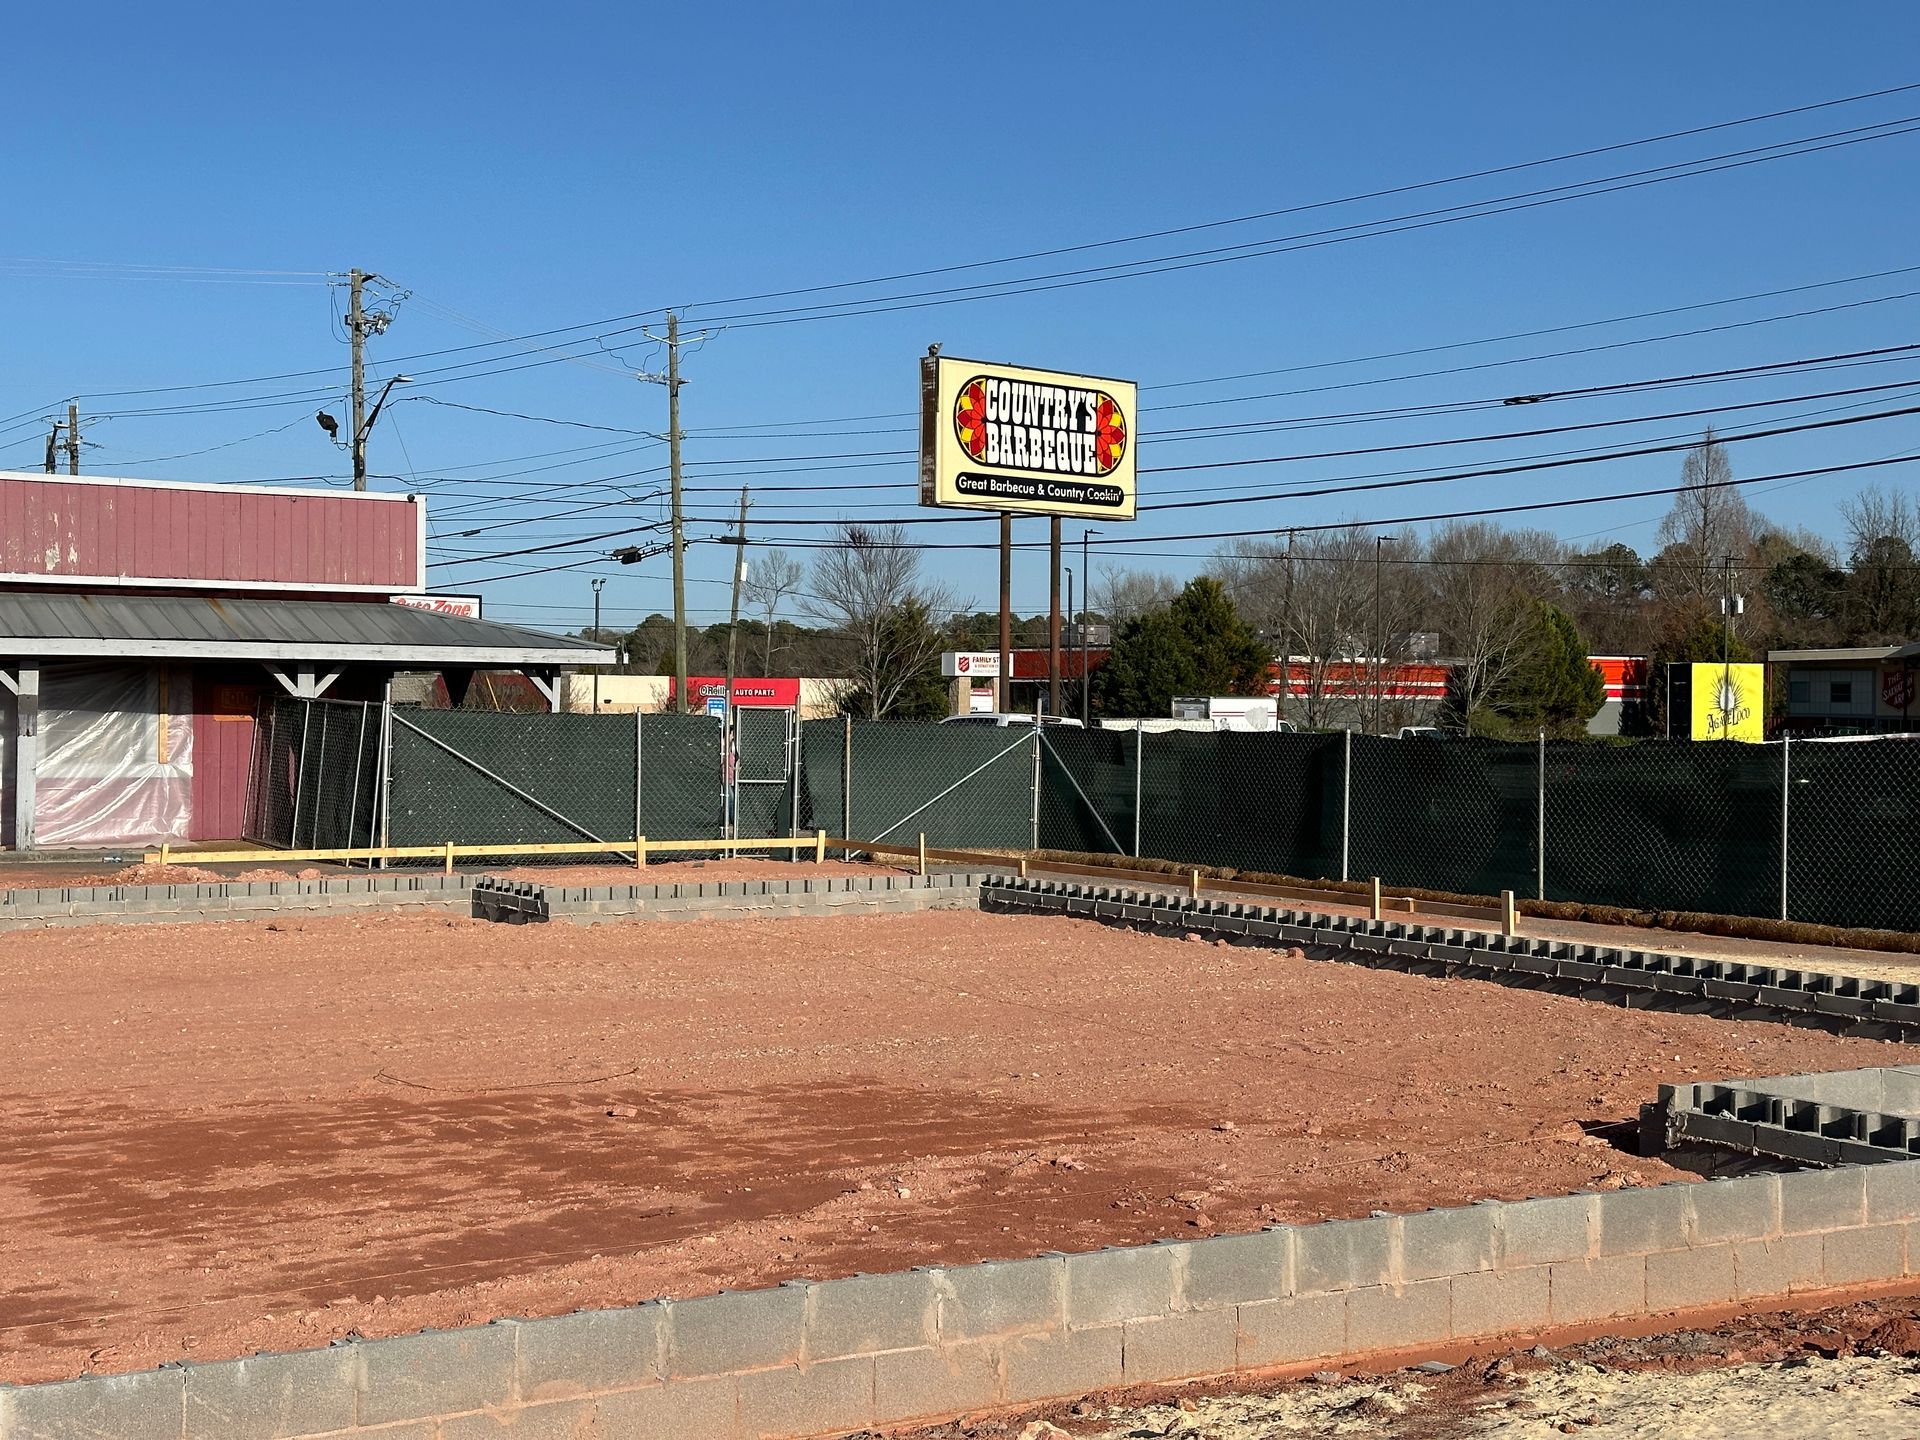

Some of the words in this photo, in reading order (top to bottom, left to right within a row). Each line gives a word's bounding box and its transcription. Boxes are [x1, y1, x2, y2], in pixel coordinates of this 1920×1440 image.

[986, 379, 1097, 433] COUNTRY'S
[986, 422, 1097, 474] BARBEQUE
[958, 476, 988, 491] Great
[990, 480, 1035, 495] Barbecue
[1037, 485, 1045, 495] &
[1047, 484, 1083, 502] Country
[1087, 487, 1122, 502] Cookin'
[700, 684, 726, 697] O'Reill
